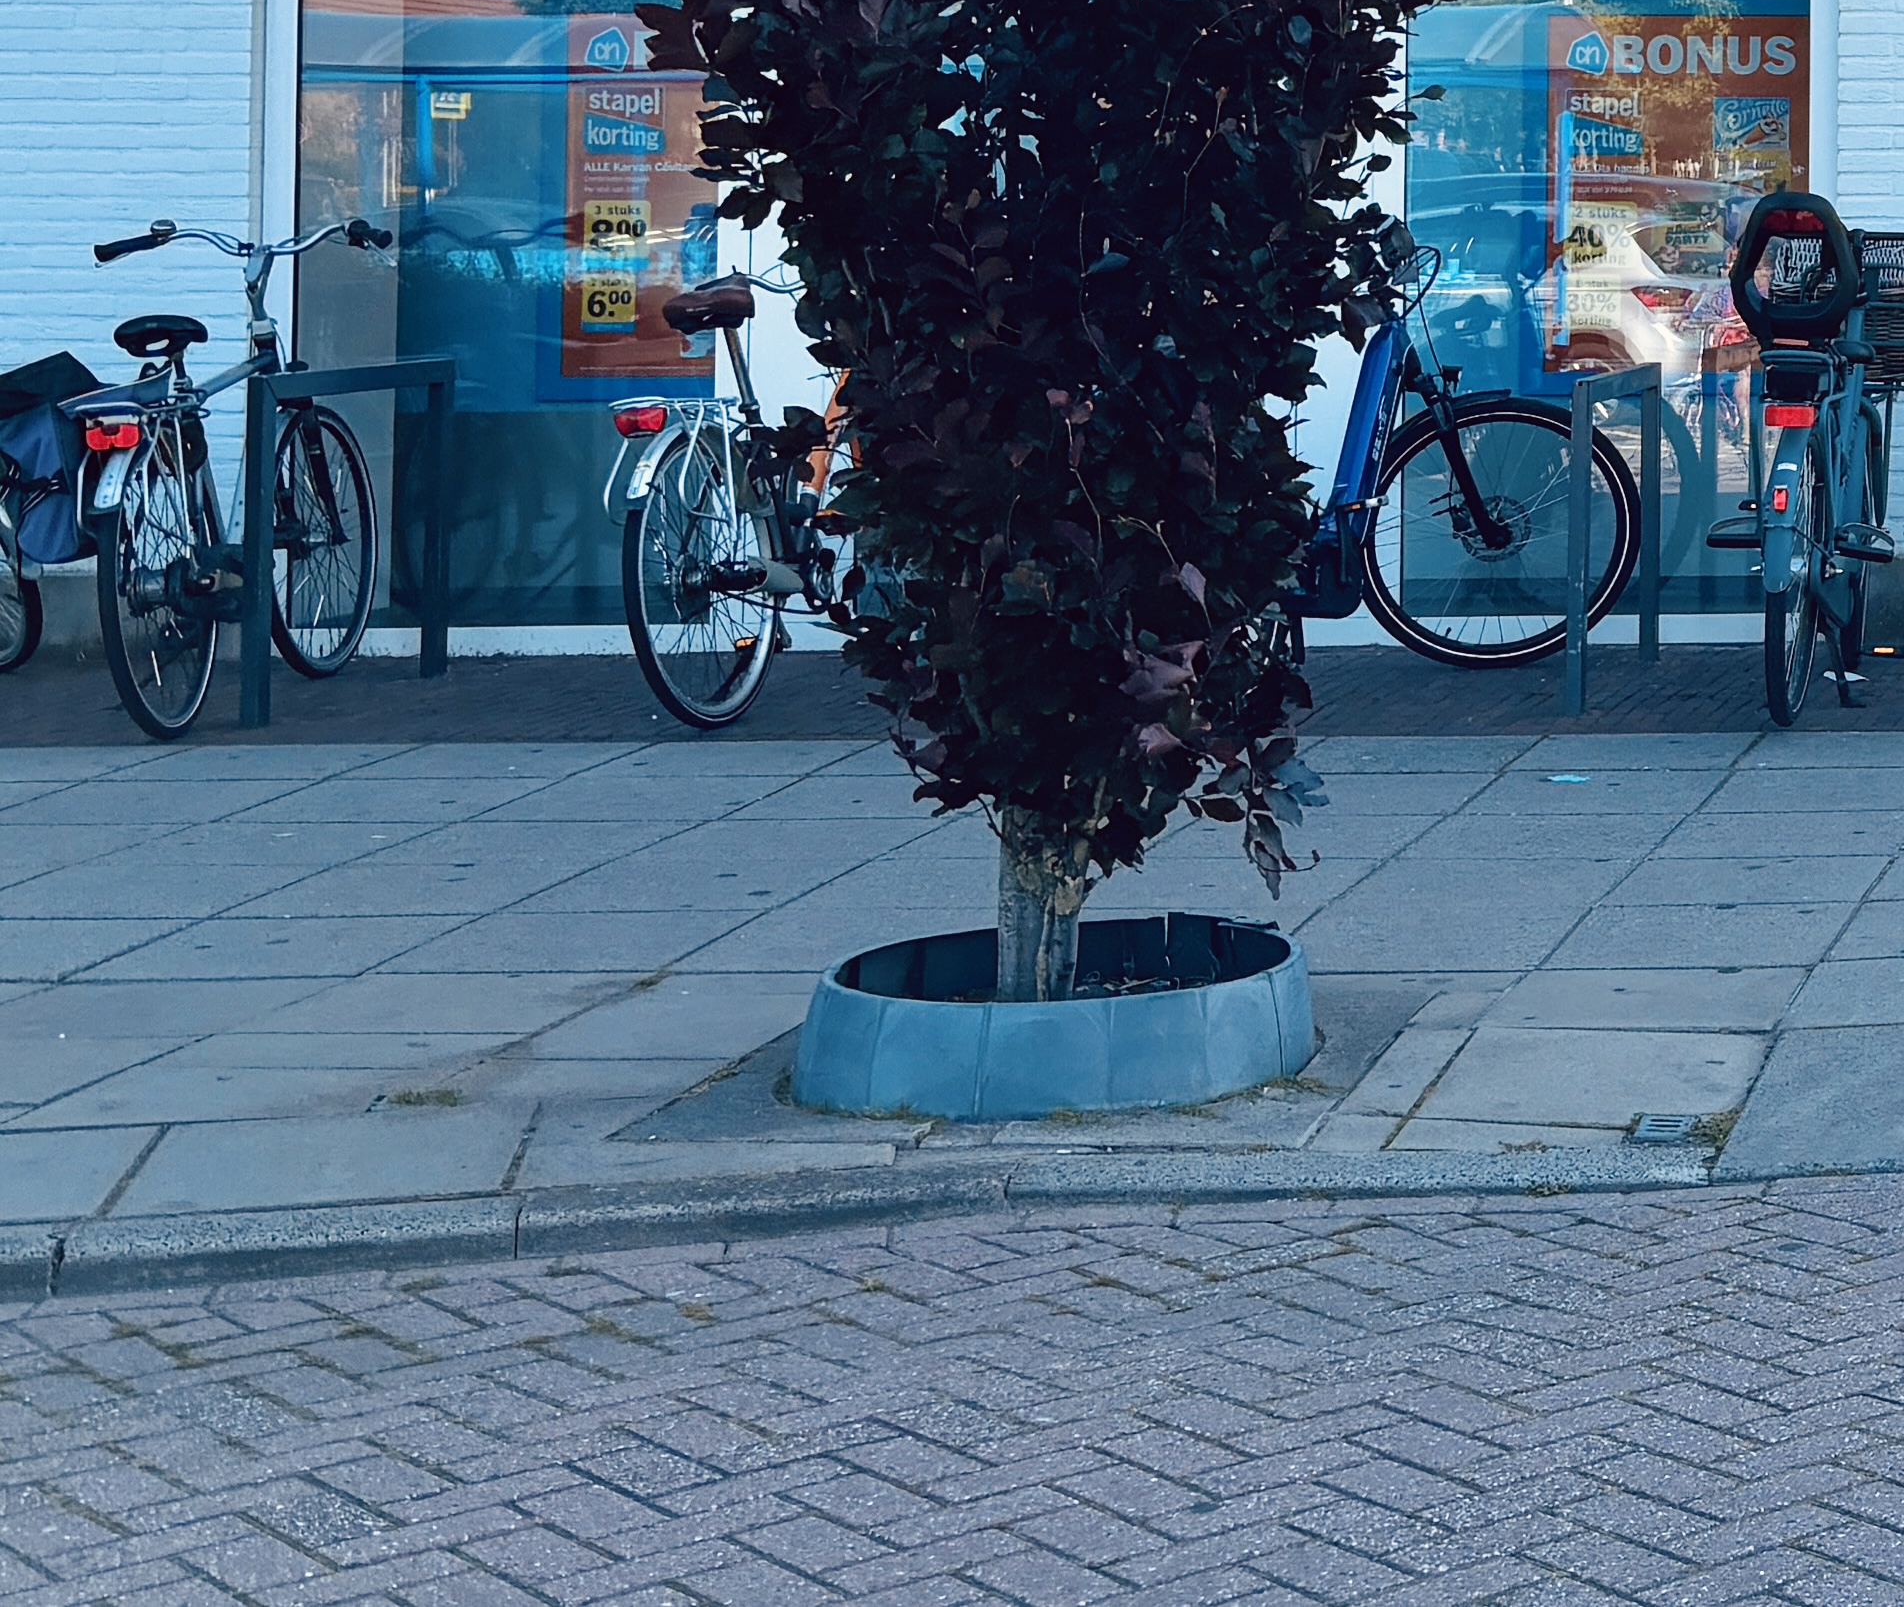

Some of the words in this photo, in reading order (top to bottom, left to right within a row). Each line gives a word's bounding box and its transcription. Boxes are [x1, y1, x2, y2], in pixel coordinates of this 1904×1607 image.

[1613, 34, 1797, 76] BONUS
[589, 88, 661, 118] stapel
[1570, 92, 1639, 120] stapel
[588, 118, 660, 151] korting
[1570, 126, 1639, 152] korting
[584, 162, 611, 172] ALLE
[607, 204, 642, 215] stuks
[1575, 207, 1581, 218] 2
[1589, 207, 1627, 219] stuks
[590, 219, 647, 251] 800
[1567, 223, 1631, 249] 40%
[1574, 251, 1627, 266] korting
[587, 290, 632, 318] 6.00
[1567, 293, 1617, 313] 30%
